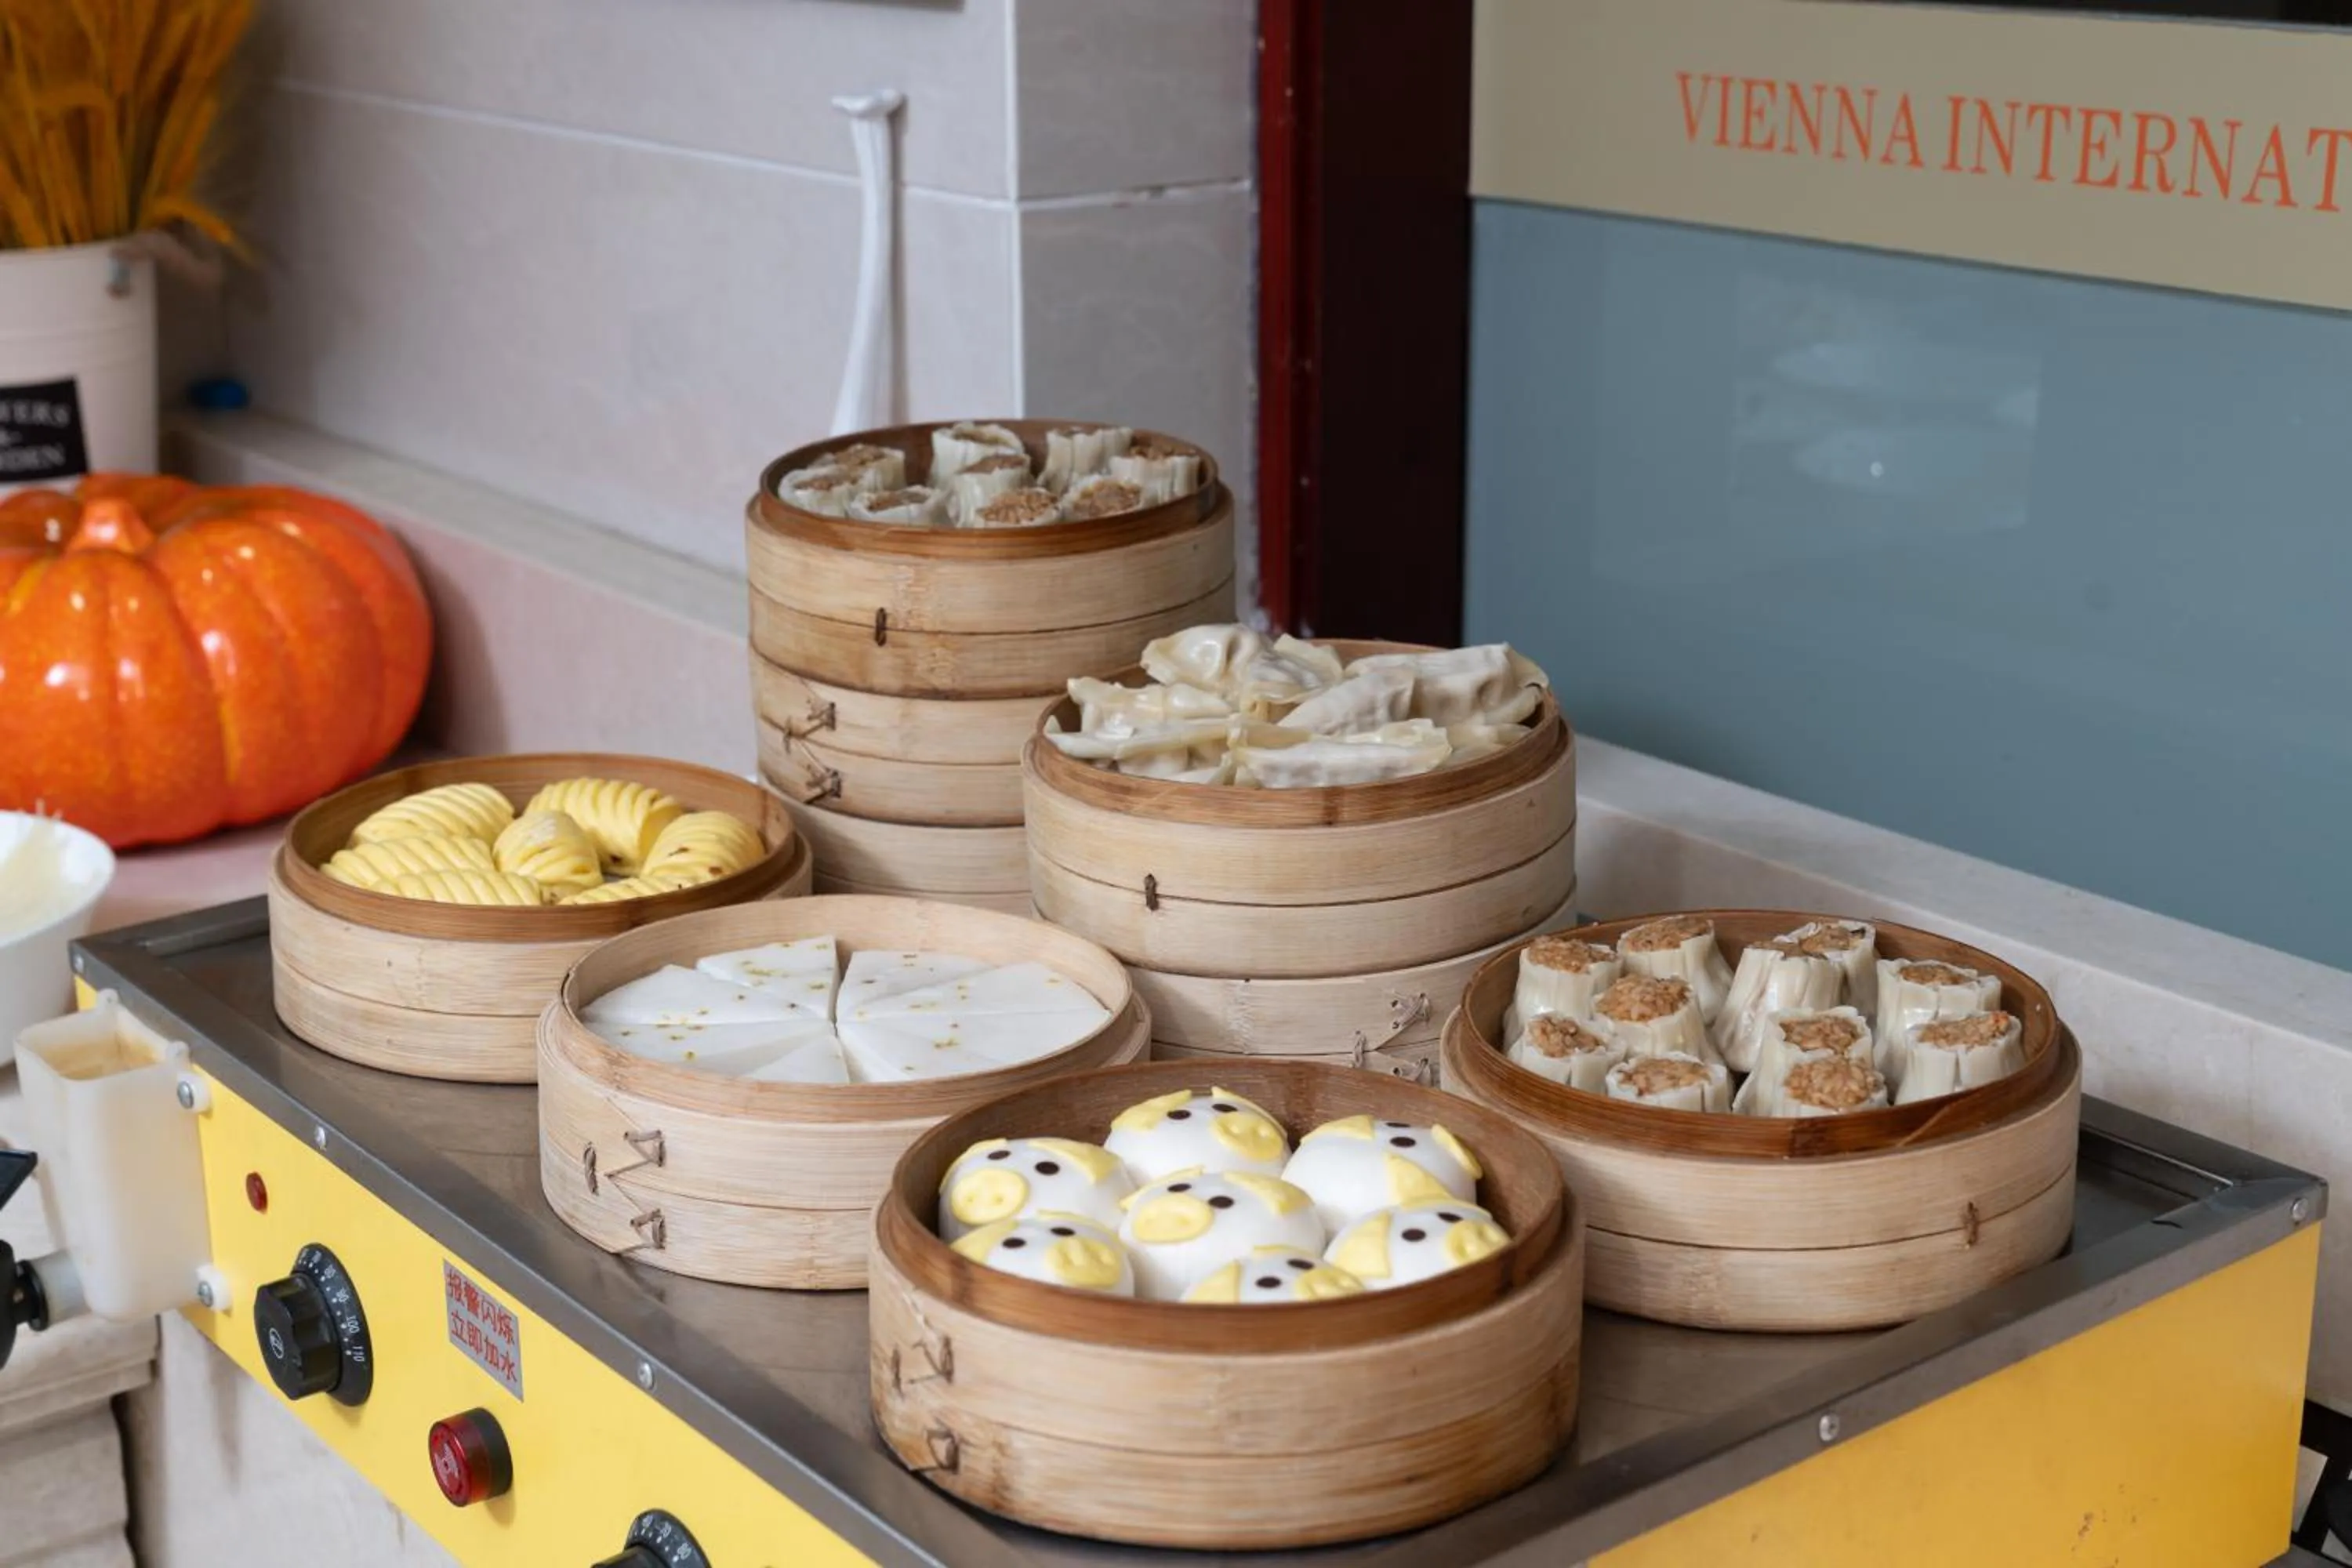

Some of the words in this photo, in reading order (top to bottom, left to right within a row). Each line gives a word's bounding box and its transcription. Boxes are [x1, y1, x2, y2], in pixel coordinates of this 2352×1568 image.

[1675, 70, 1925, 168] VIENNA
[1941, 95, 2352, 212] INTERNAT
[345, 1315, 360, 1334] 100
[446, 1269, 516, 1345] 报警闪烁
[351, 1345, 365, 1363] 110
[451, 1310, 518, 1382] 立即加水
